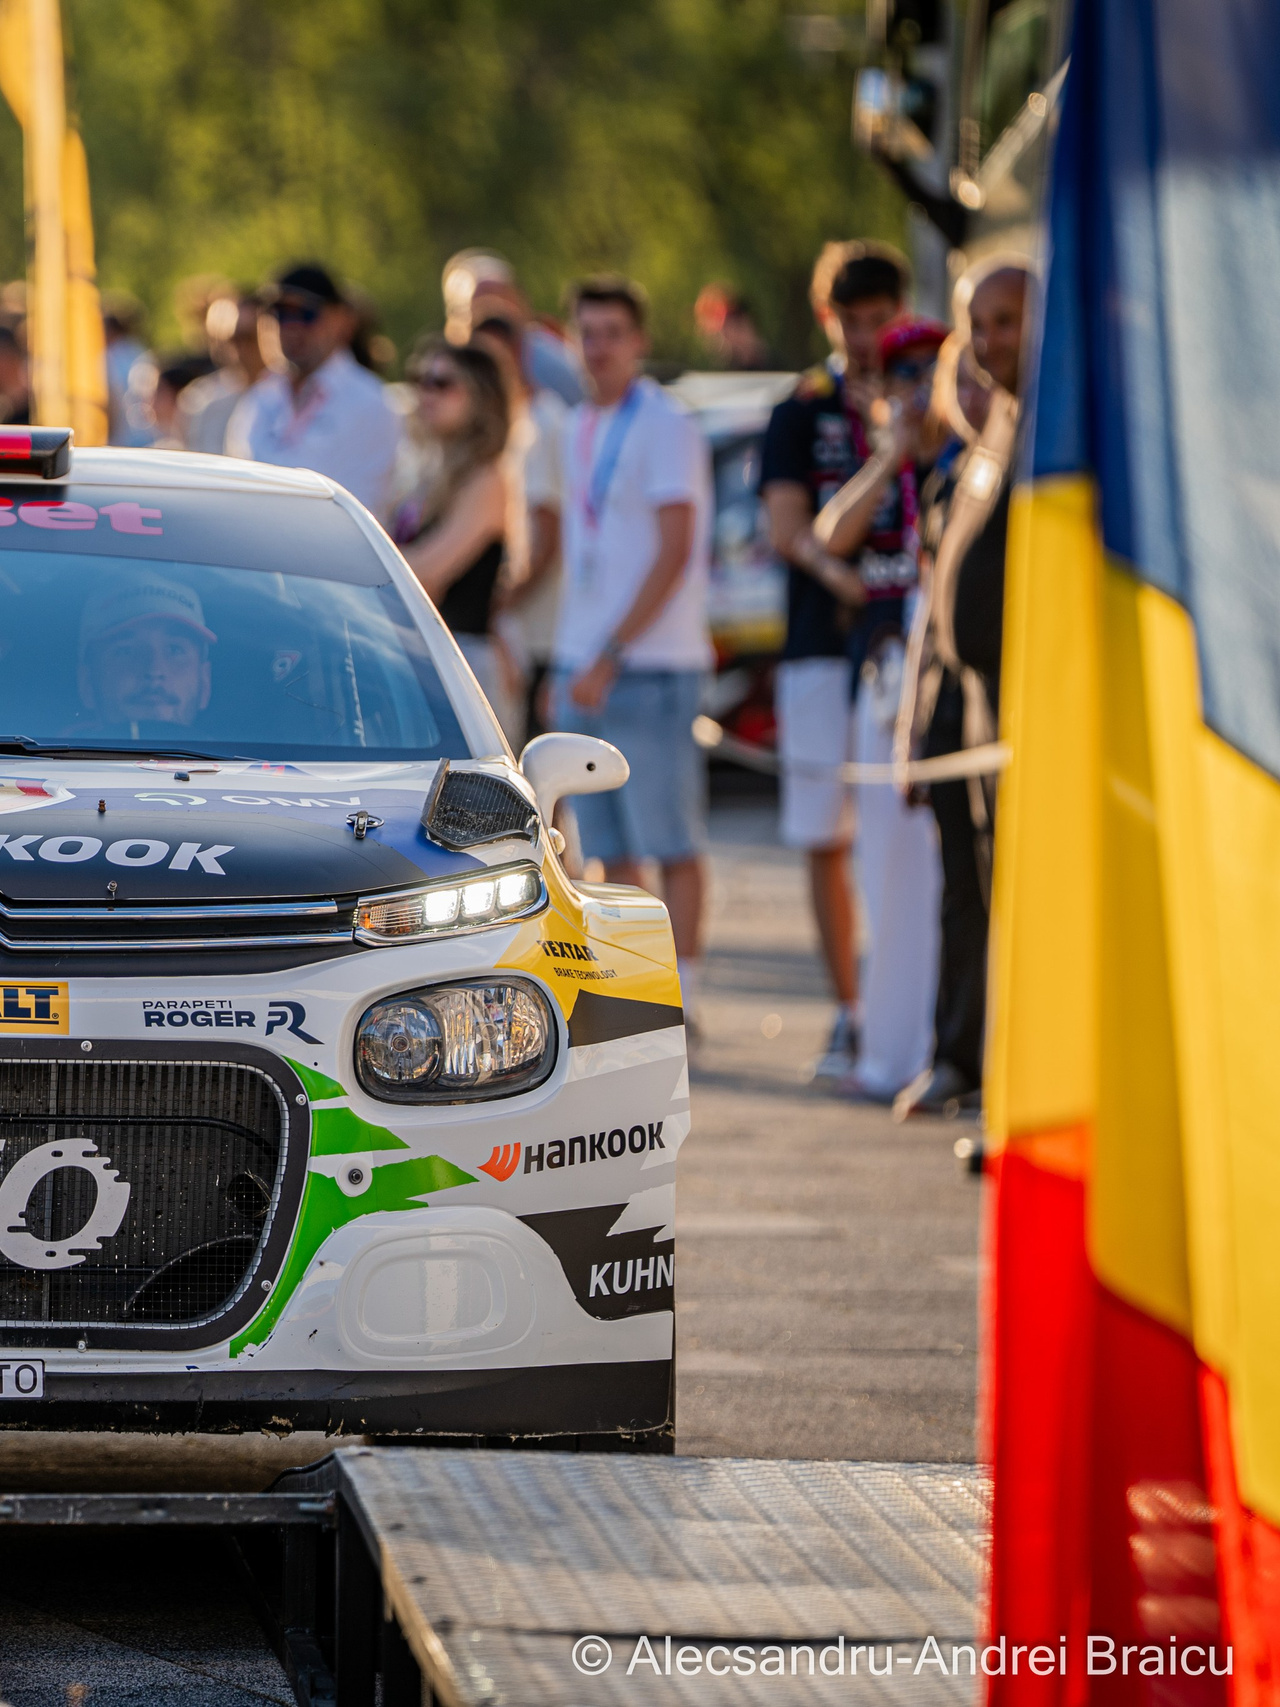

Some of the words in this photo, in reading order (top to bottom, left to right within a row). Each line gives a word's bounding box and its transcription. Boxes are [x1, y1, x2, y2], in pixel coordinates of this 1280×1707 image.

[221, 794, 361, 808] OMV
[536, 940, 599, 962] TEXTAR
[553, 967, 574, 979] BRAKE
[574, 969, 618, 980] TECHNOLOGY
[142, 1000, 232, 1010] PARAPETI
[144, 1010, 256, 1028] ROGER
[589, 1254, 675, 1298] KUHN
